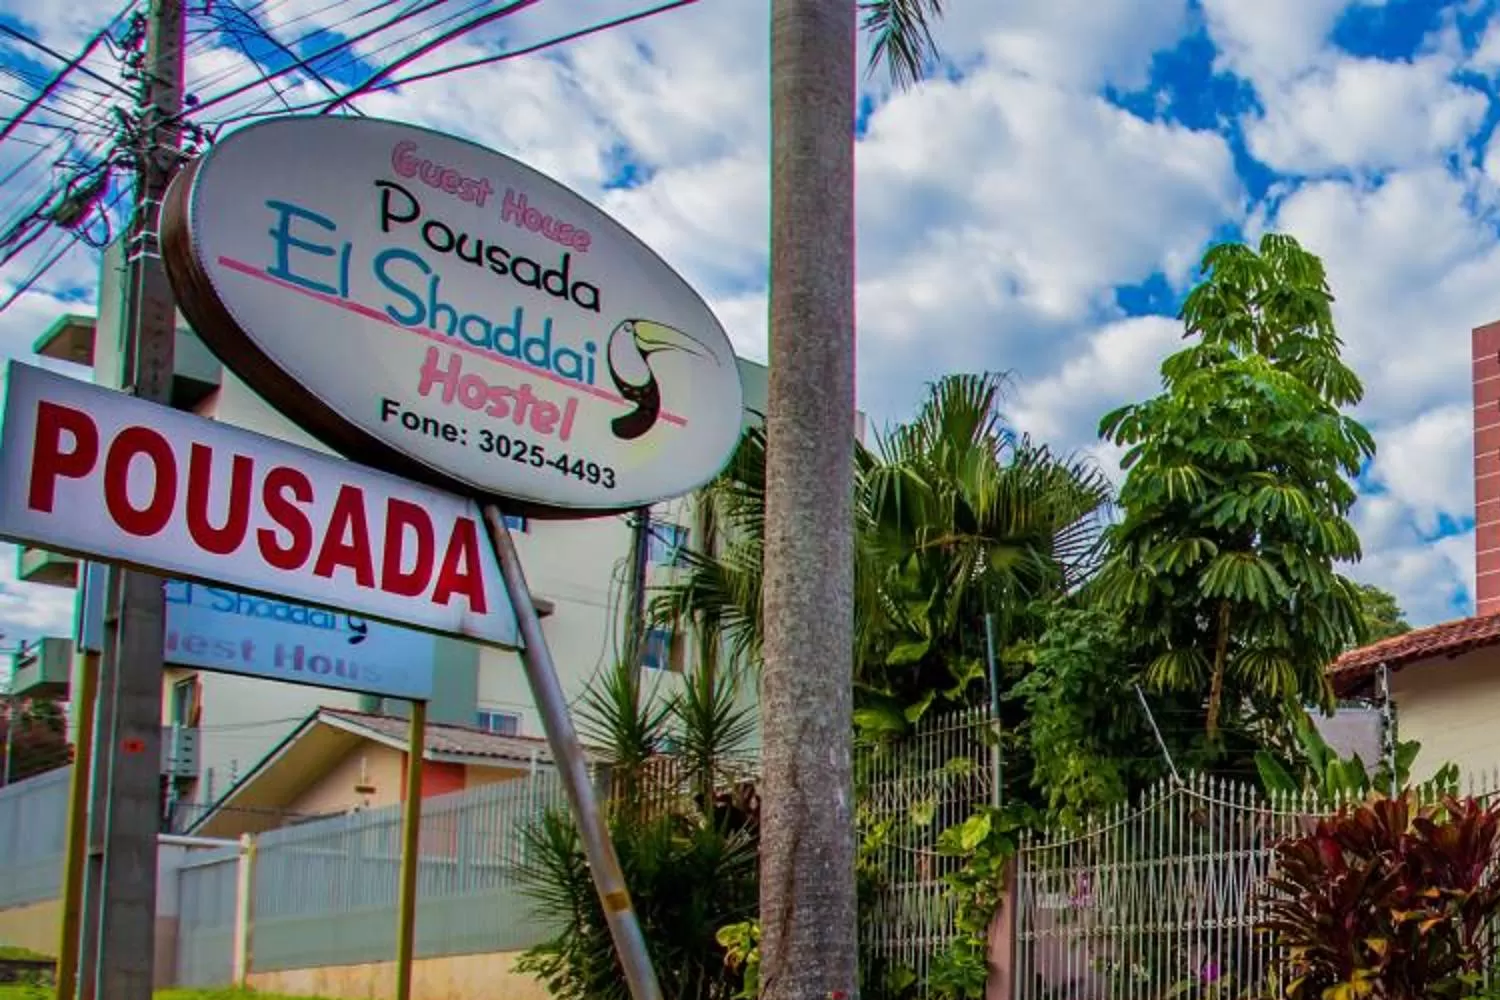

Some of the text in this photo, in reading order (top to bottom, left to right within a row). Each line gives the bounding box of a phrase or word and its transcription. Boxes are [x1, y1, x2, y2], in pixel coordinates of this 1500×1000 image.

[374, 179, 601, 313] Pousada
[391, 139, 593, 254] Guest House
[265, 199, 598, 386] El Shaddai
[379, 397, 617, 490] Fone: 3025-4493
[417, 346, 579, 442] Hostel
[27, 400, 488, 615] POUSADA
